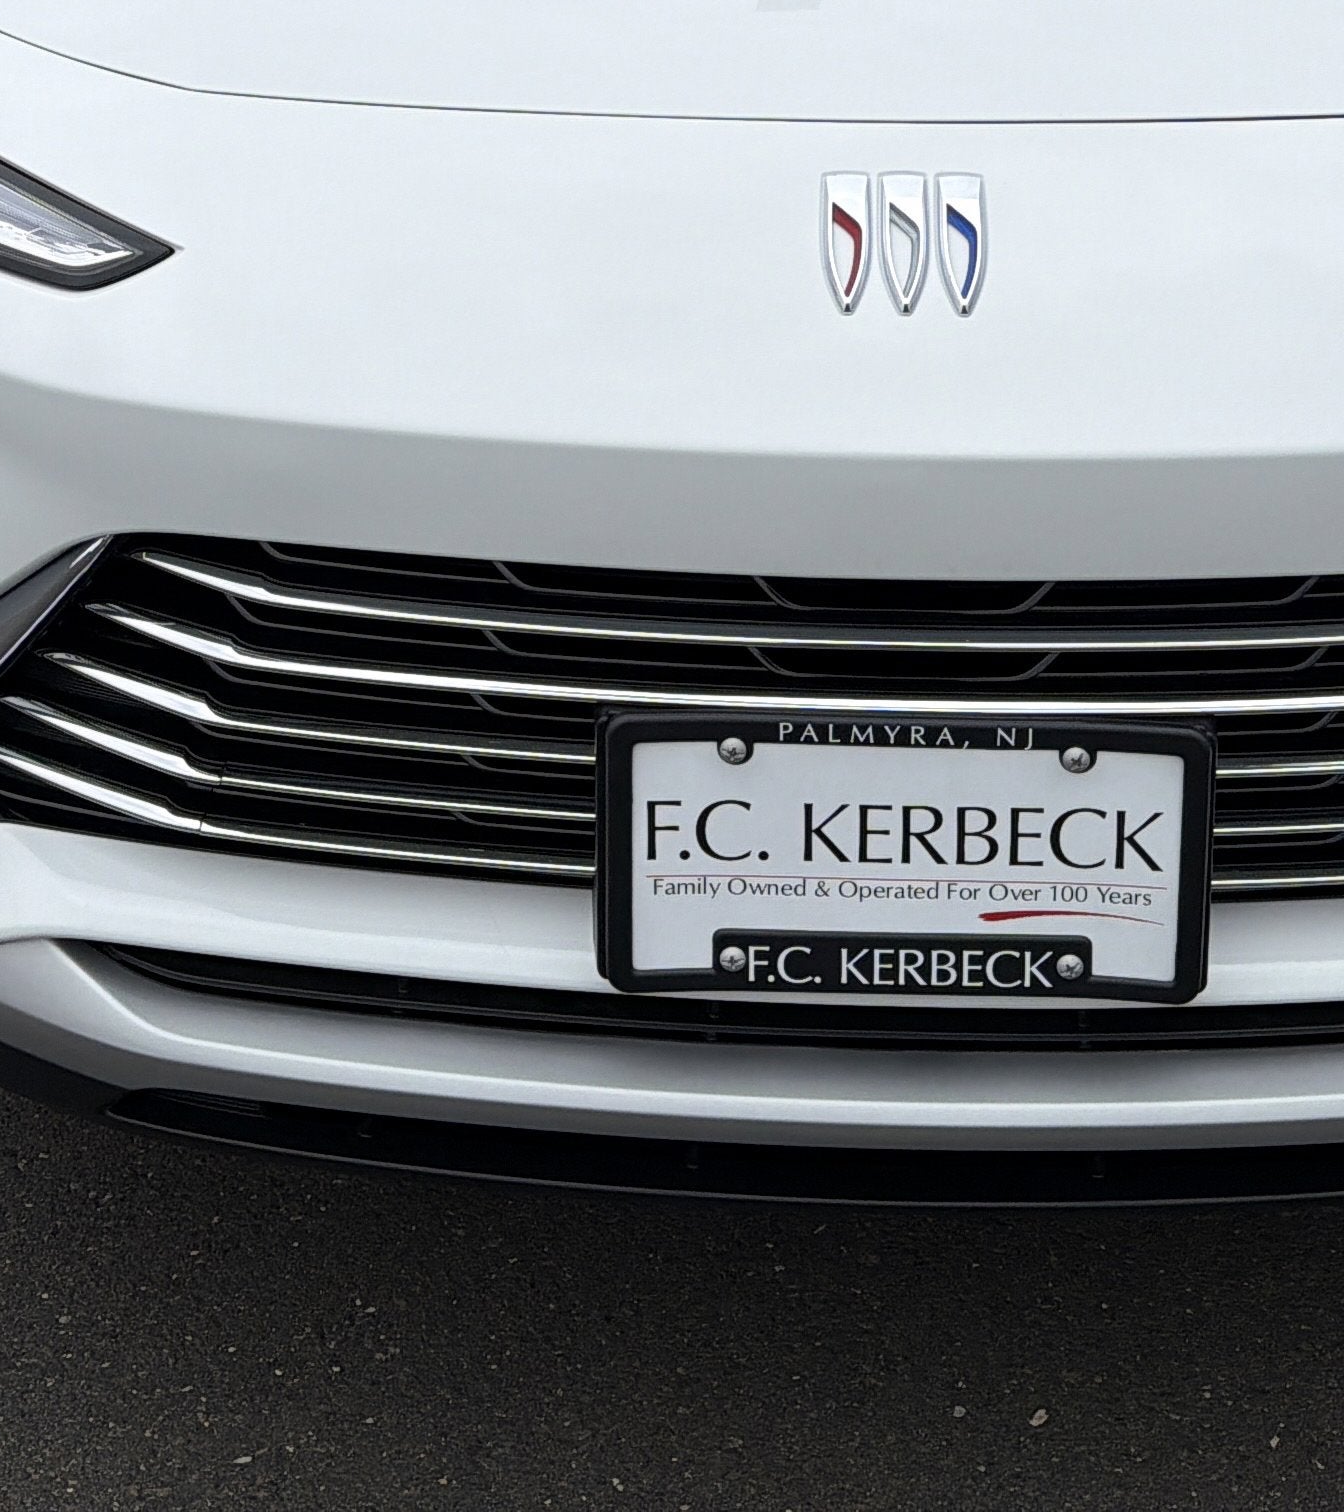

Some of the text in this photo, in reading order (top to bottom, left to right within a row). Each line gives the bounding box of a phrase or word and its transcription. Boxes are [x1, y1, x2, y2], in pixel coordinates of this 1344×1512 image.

[777, 721, 1034, 751] PALMYRA, NJ
[646, 798, 1165, 873] F.C. KERBECK
[652, 875, 1153, 907] Family Owned & Operated For Over 100 Years
[747, 944, 1054, 989] F.C. KERBECK
